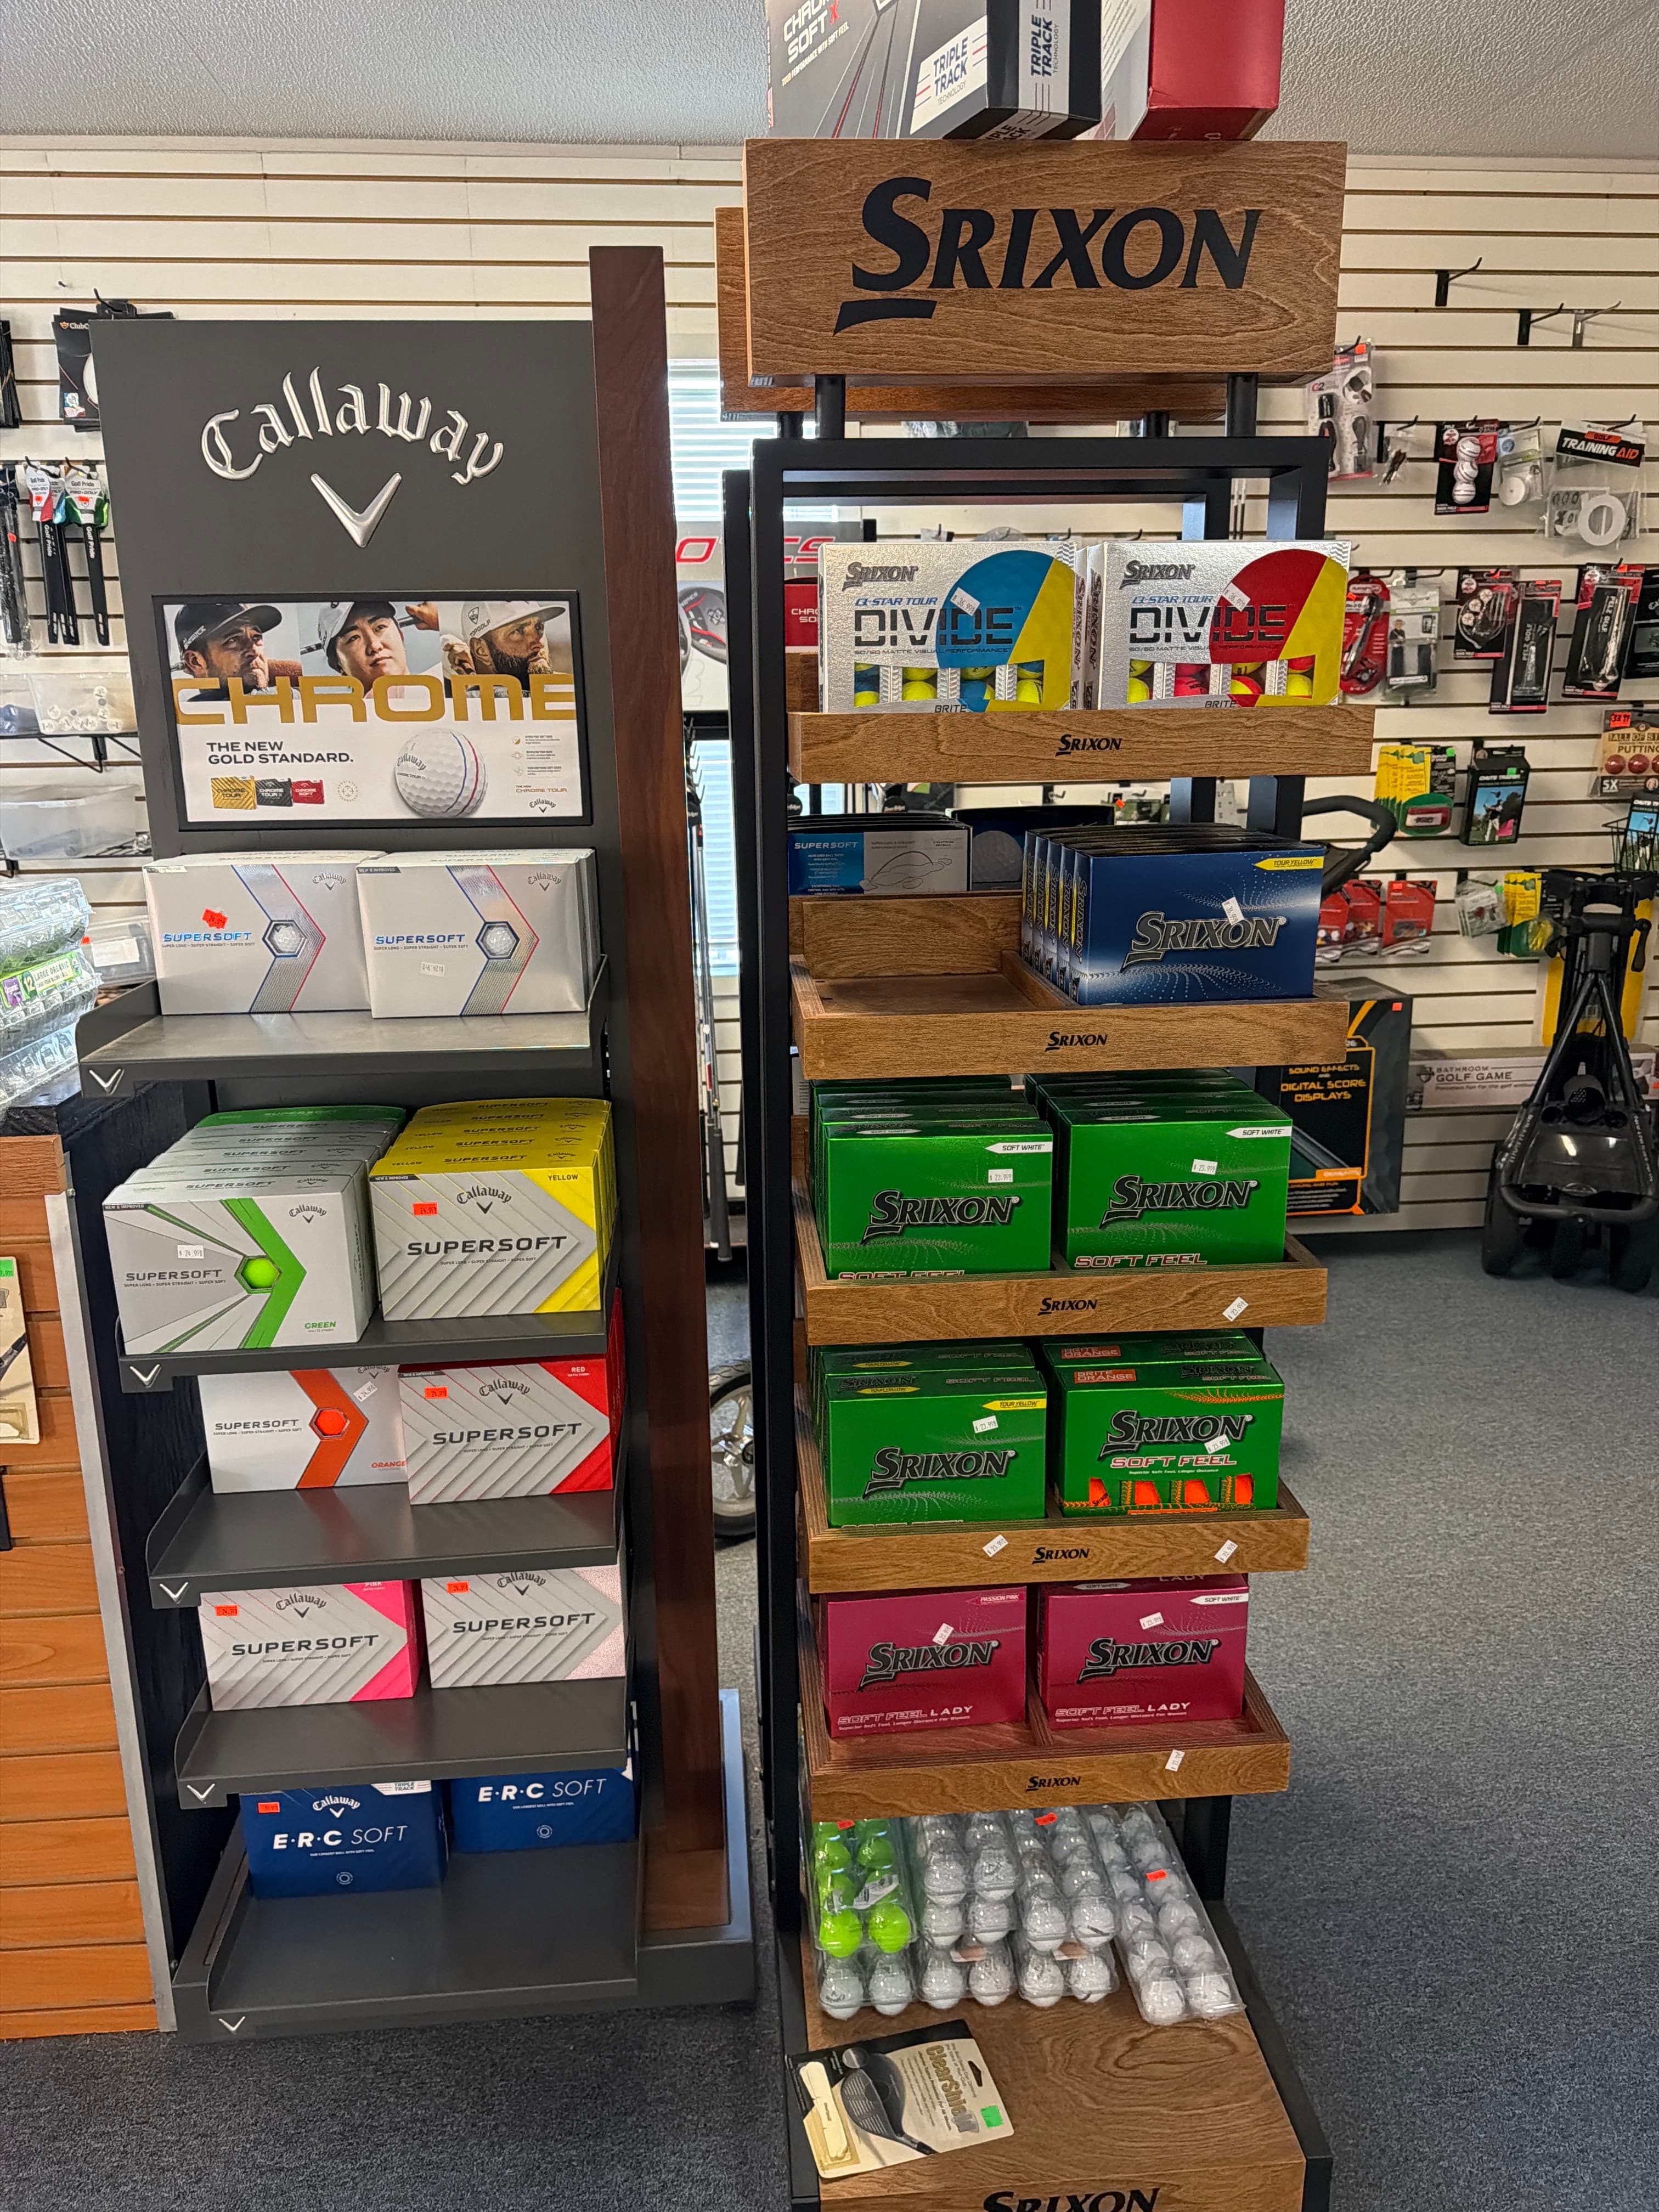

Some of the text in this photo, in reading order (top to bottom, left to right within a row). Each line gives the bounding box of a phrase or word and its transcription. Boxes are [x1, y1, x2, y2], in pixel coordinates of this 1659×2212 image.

[783, 0, 829, 42] CHRO
[788, 9, 828, 64] SOFT
[1031, 14, 1042, 76] TRIPLE
[933, 36, 969, 77] TRIPLE
[1041, 18, 1053, 77] TRACK
[934, 57, 967, 97] TRACK
[938, 81, 967, 106] TECHNOLOGY
[850, 176, 1263, 292] SRIXON
[201, 365, 504, 487] Callaway
[1561, 437, 1639, 460] TRAINING AID
[844, 561, 918, 582] SRIXON
[1123, 559, 1195, 580] SRIXON
[854, 596, 938, 606] Q-STAR TOUR
[1132, 594, 1214, 604] Q-STAR TOUR
[469, 618, 492, 637] TOPGOLF
[854, 607, 1014, 647] DIVIDE
[1074, 576, 1086, 670] SRIXON
[1090, 572, 1102, 670] SRIXON
[1129, 605, 1287, 644] DIVIDE
[172, 673, 576, 726] CHROME
[934, 704, 967, 714] BRITE
[1205, 700, 1237, 708] BRITE
[206, 741, 284, 752] THE NEW
[1059, 733, 1122, 752] SRIXON
[208, 752, 354, 764] GOLD STANDARD.
[397, 752, 427, 771] Callaway
[529, 798, 557, 808] Callaway
[794, 842, 858, 850] SUPERSOFT
[312, 871, 347, 884] Callaway
[527, 871, 562, 885] Callaway
[1076, 879, 1087, 963] SRIXON
[1131, 911, 1279, 950] SRIXON
[163, 932, 252, 943] SUPERSOFT
[376, 934, 466, 944] SUPERSOFT
[33, 969, 49, 981] LARGE
[49, 961, 70, 975] ORGANIC
[1048, 1031, 1108, 1046] SRIXON
[1288, 1066, 1320, 1075] SOUND
[1436, 1071, 1513, 1082] GOLF GAME
[1280, 1079, 1367, 1092] DIGITAL SCORE
[1294, 1091, 1352, 1103] DISPLAYS
[185, 1181, 275, 1189] SUPERSOFT
[456, 1184, 512, 1205] Callaway
[1109, 1175, 1250, 1210] SRIXON
[289, 1204, 328, 1217] Callaway
[870, 1189, 1013, 1225] SRIXON
[407, 1235, 568, 1256] SUPERSOFT
[1074, 1253, 1207, 1268] SOFT FEEL
[126, 1269, 223, 1282] SUPERSOFT
[1040, 1297, 1097, 1312] SRIXON
[304, 1321, 337, 1329] GREEN
[478, 1378, 531, 1397] Callaway
[1077, 1374, 1134, 1382] ORANGE
[215, 1419, 301, 1431] SUPERSOFT
[432, 1423, 583, 1446] SUPERSOFT
[1107, 1410, 1246, 1442] SRIXON
[371, 1460, 407, 1469] ORANGE
[871, 1447, 1009, 1481] SRIXON
[1110, 1454, 1237, 1469] SOFT FEEL
[1034, 1547, 1090, 1561] SRIXON
[496, 1571, 546, 1588] Callaway
[275, 1592, 327, 1611] Callaway
[453, 1612, 596, 1634] SUPERSOFT
[232, 1634, 380, 1656] SUPERSOFT
[1086, 1638, 1212, 1668] SRIXON
[866, 1641, 993, 1673] SRIXON
[837, 1713, 885, 1725] SOFT
[885, 1709, 928, 1722] FEEL
[929, 1705, 974, 1717] LADY
[1054, 1707, 1103, 1718] SOFT
[1103, 1704, 1145, 1715] FEEL
[1147, 1702, 1191, 1713] LADY
[552, 1778, 607, 1798] SOFT
[1028, 1775, 1081, 1788] SRIXON
[312, 1795, 360, 1811] Callaway
[351, 1825, 408, 1845] SOFT
